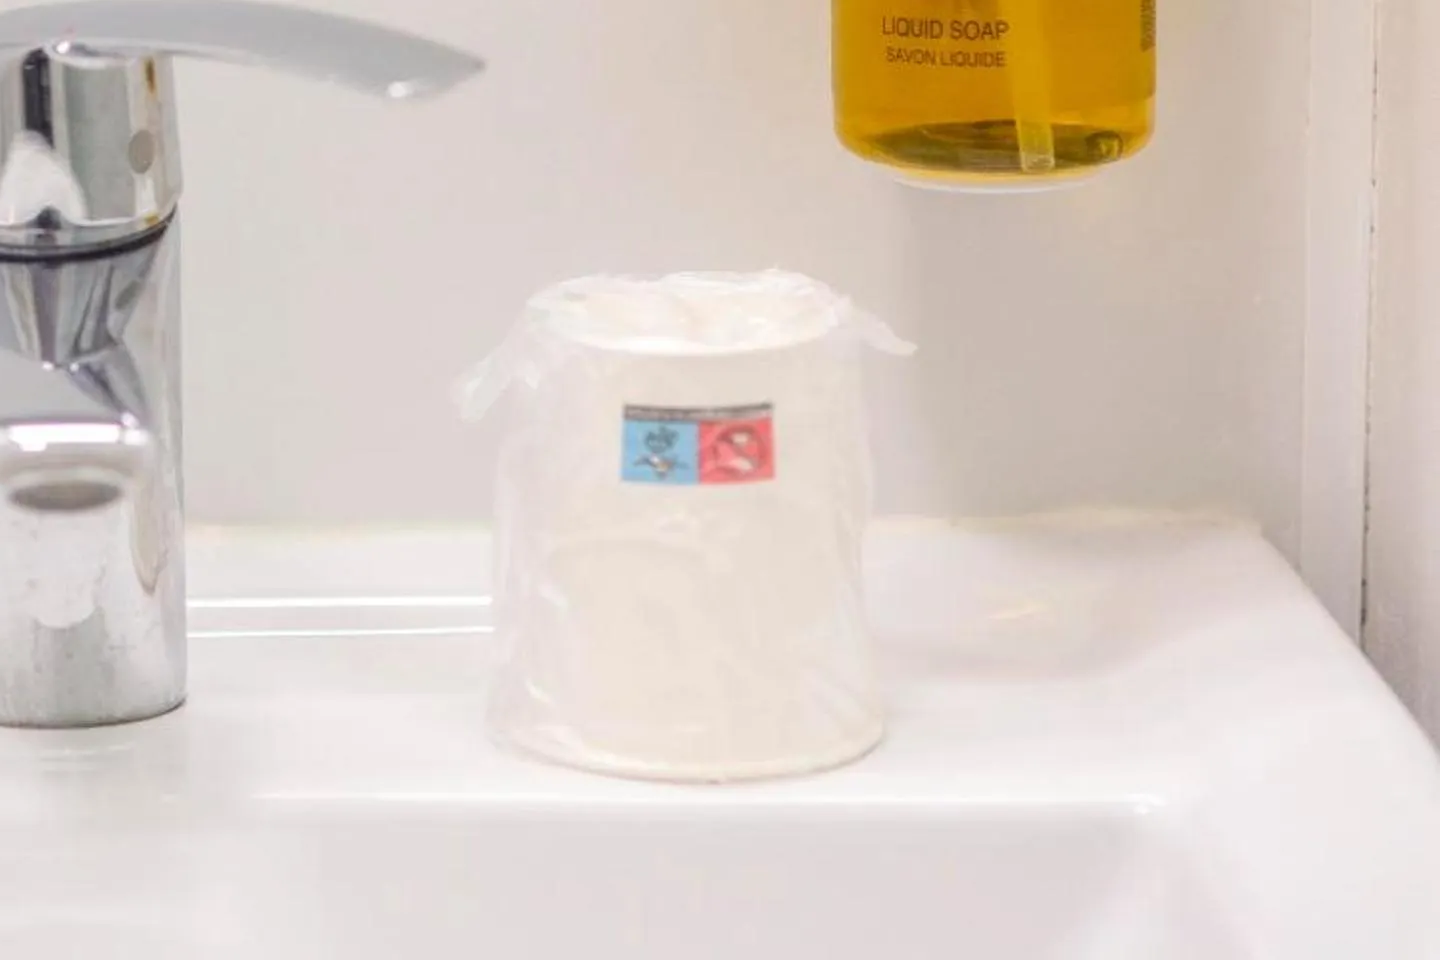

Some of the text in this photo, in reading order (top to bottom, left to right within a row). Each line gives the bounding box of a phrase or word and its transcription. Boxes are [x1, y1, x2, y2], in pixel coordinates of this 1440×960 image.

[882, 16, 1010, 41] LIQUID SOAP
[885, 46, 1007, 69] SAVON LIQUIDE
